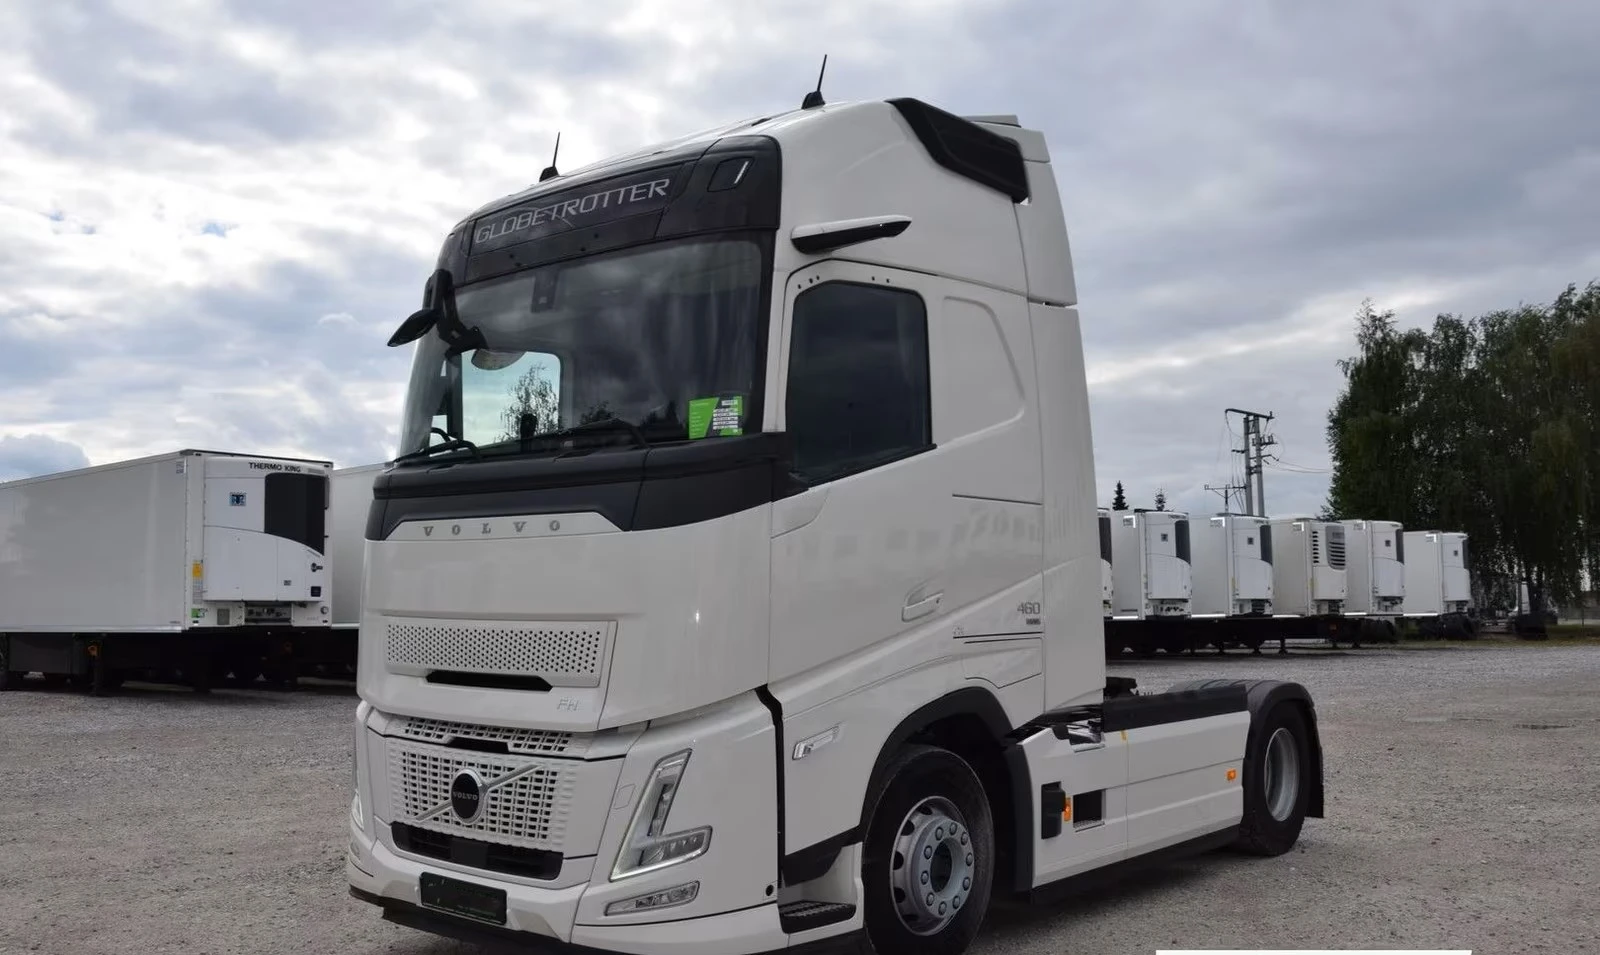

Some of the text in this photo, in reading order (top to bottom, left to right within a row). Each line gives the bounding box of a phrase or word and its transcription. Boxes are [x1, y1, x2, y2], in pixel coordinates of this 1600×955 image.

[475, 178, 670, 244] GLOBETROTTER
[248, 462, 282, 471] THERMO
[423, 520, 561, 537] VOLVO
[1017, 601, 1041, 615] 460
[556, 698, 579, 711] FH
[452, 791, 479, 800] VOLVO
